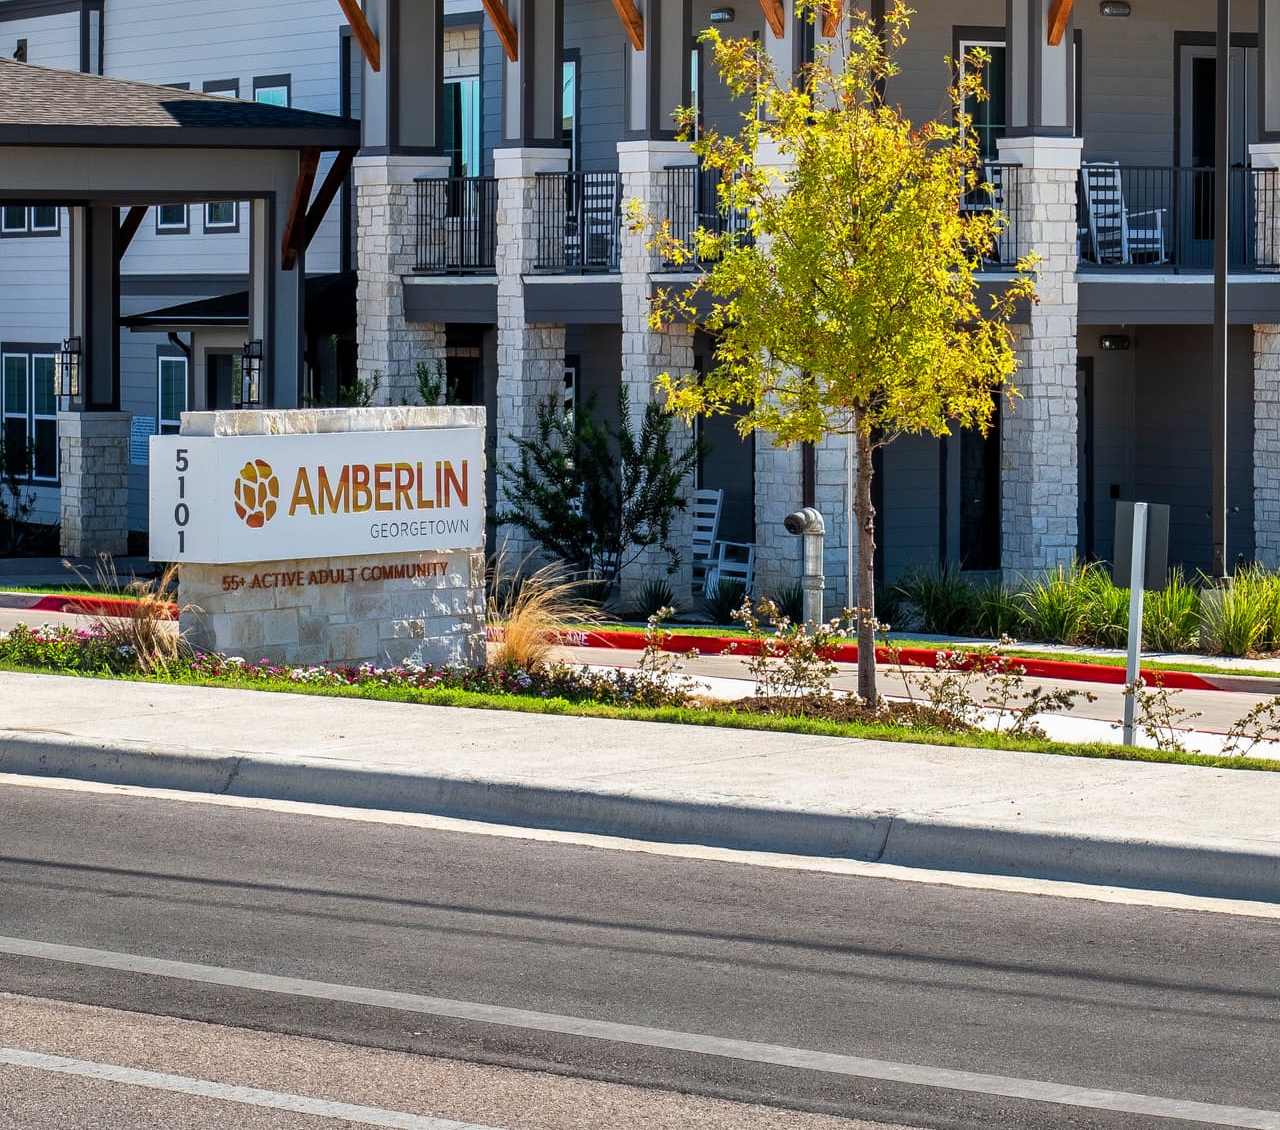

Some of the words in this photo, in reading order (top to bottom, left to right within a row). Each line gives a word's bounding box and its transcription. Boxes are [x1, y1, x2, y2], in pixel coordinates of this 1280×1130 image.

[287, 459, 469, 518] AMBERLIN
[370, 518, 469, 539] GEORGETOWN
[222, 574, 247, 591] 55+
[251, 570, 305, 589] ACTIVE
[308, 567, 357, 585] ADULT
[360, 561, 449, 582] COMMUNITY
